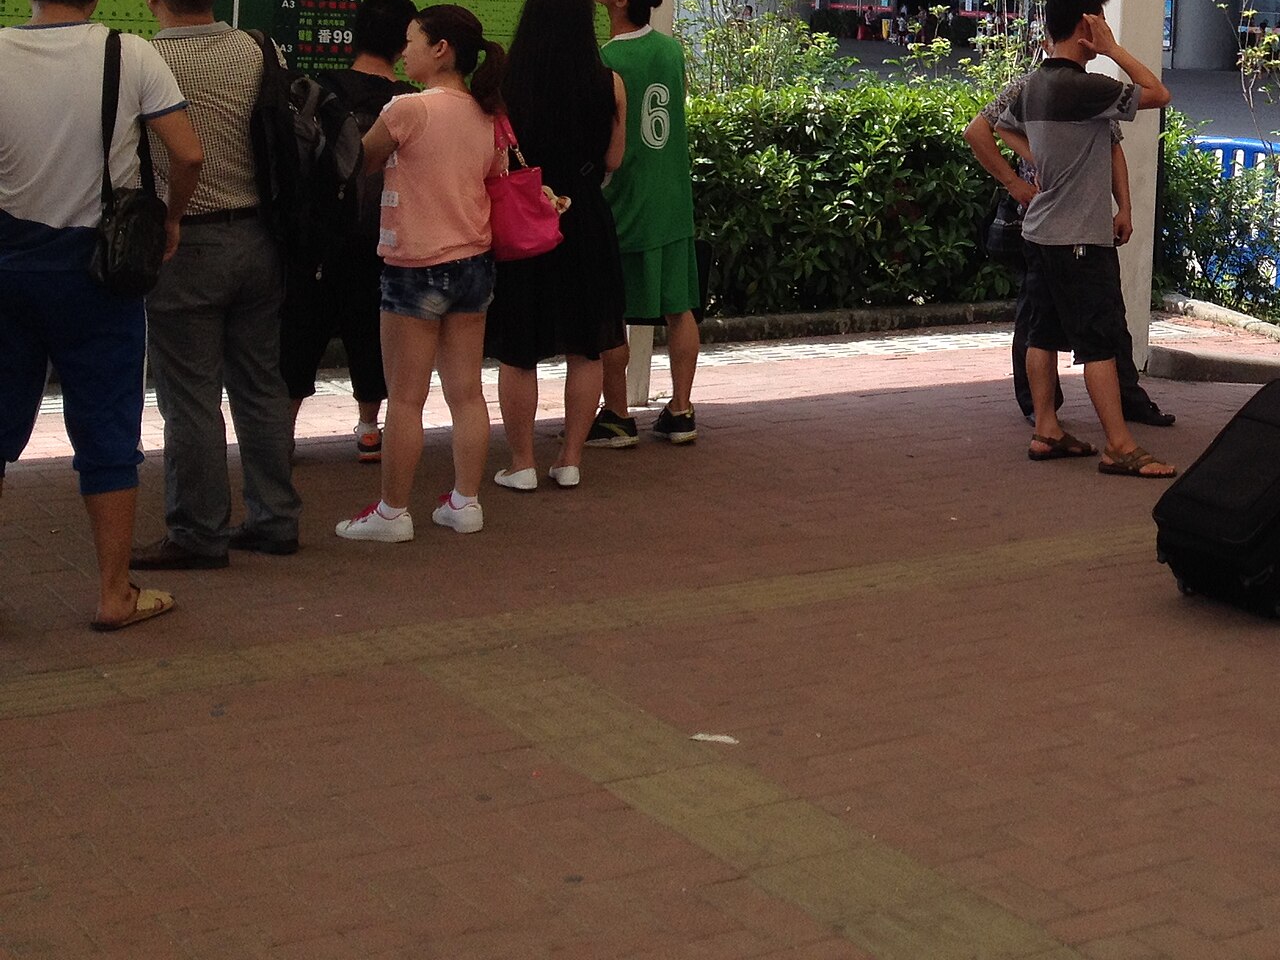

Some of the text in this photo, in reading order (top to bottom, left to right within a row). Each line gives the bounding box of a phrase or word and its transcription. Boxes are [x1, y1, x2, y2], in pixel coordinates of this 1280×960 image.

[281, 0, 296, 9] A3
[318, 29, 353, 44] 番99
[280, 43, 293, 53] A3
[640, 82, 671, 150] 6
